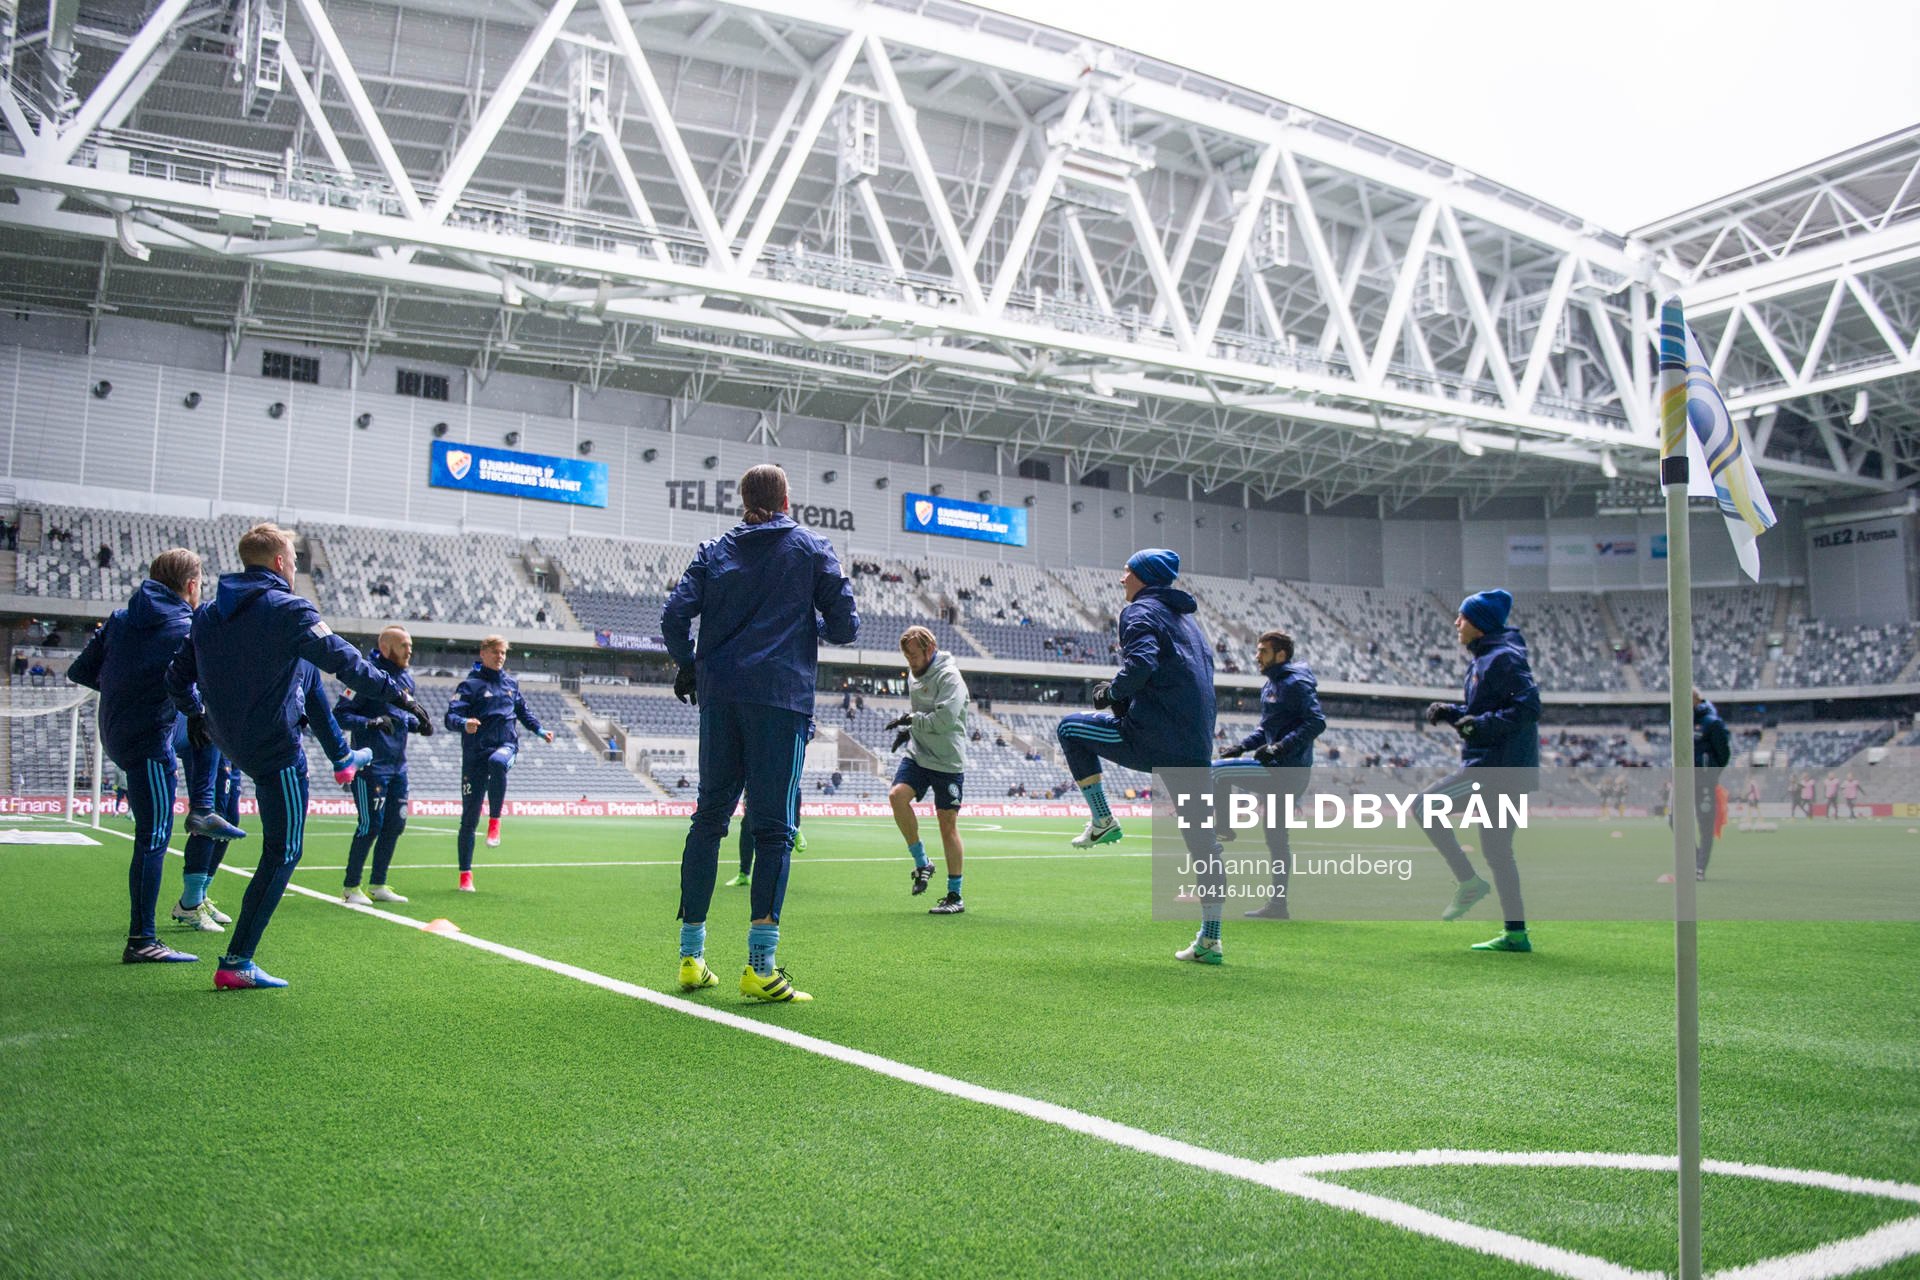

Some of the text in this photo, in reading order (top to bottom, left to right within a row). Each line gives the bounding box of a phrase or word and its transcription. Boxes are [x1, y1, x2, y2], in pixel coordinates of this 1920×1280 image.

[790, 503, 855, 531] rena
[1813, 528, 1897, 548] TELE2 Arena
[10, 798, 61, 812] Finans
[307, 799, 358, 814] Priorite
[373, 798, 386, 811] 77
[412, 801, 463, 815] Priorite
[512, 802, 565, 816] Prioritet
[566, 803, 603, 816] Finans
[608, 803, 693, 816] Prioritet Finans
